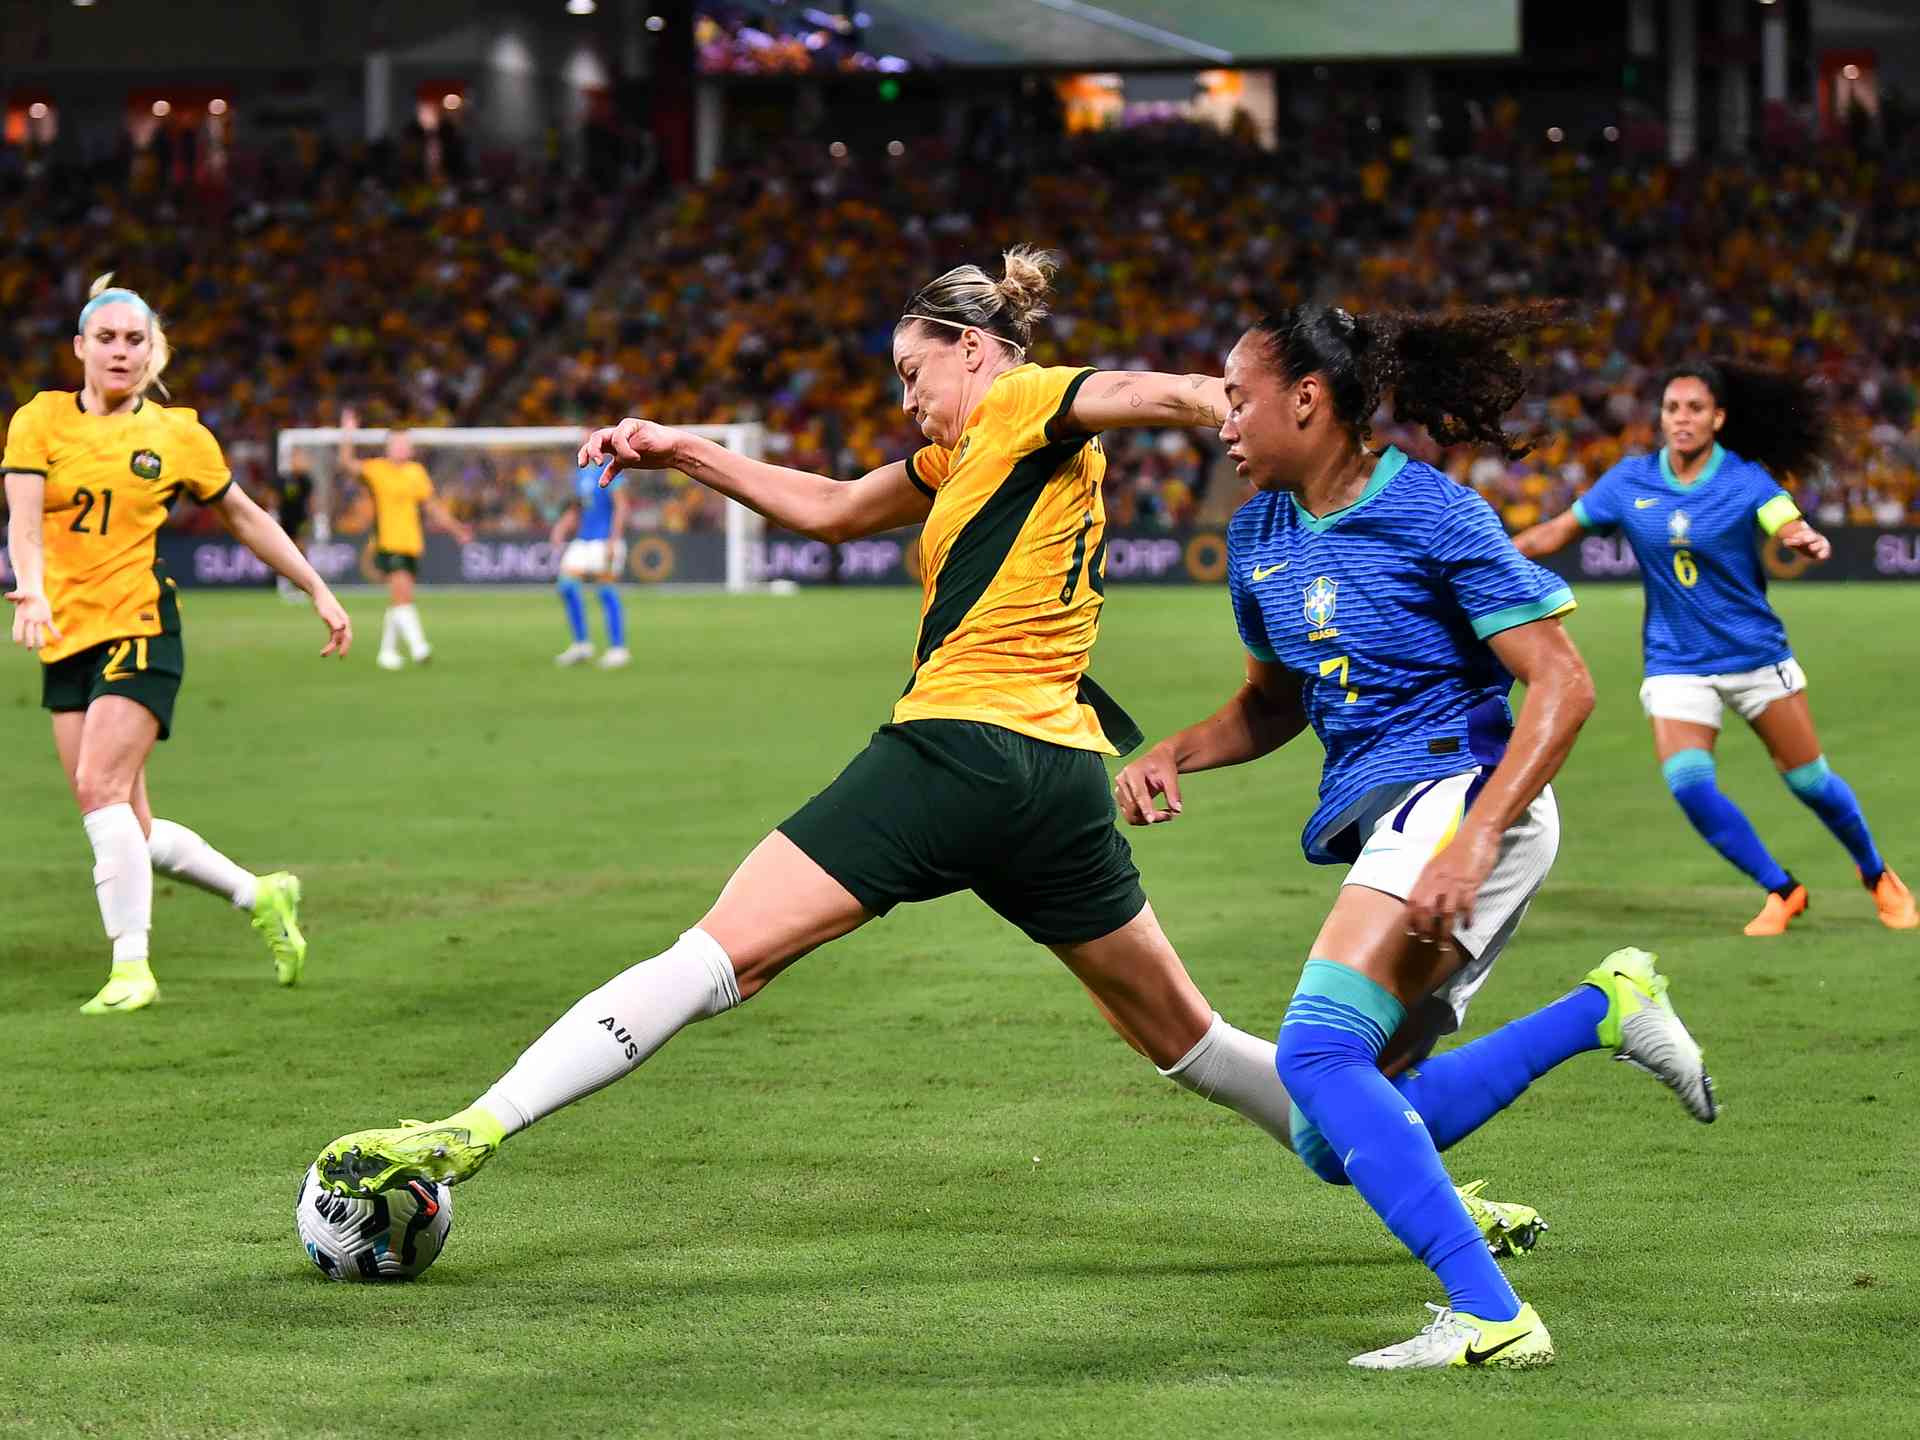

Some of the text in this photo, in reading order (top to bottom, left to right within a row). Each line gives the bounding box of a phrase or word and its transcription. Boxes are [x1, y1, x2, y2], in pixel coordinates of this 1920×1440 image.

[70, 487, 112, 535] 21
[1674, 550, 1698, 588] 6
[103, 639, 148, 681] 21
[1319, 656, 1359, 704] 7
[598, 1017, 638, 1060] AUS
